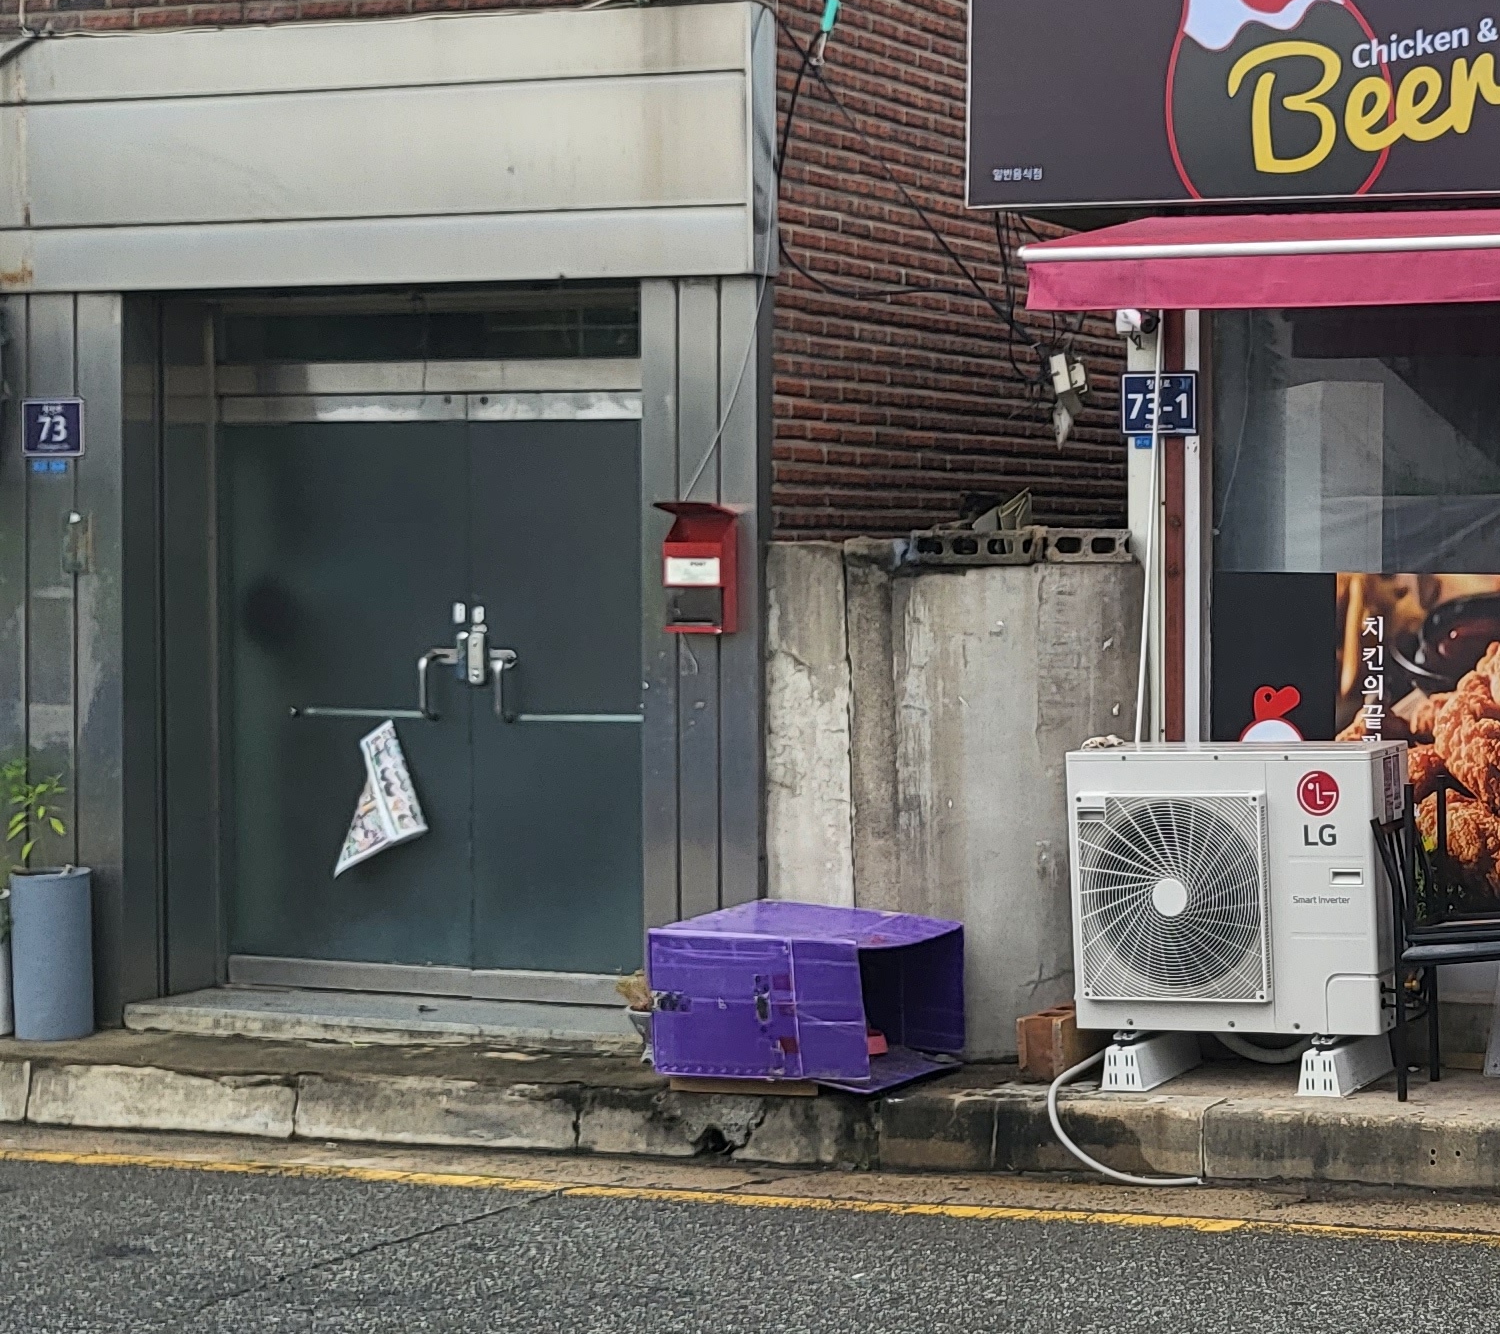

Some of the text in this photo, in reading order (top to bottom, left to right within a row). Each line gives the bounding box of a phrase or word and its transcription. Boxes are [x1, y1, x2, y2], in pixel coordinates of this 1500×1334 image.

[1351, 17, 1499, 69] Chicken &
[1127, 393, 1188, 420] 73-1
[37, 414, 67, 443] 73
[1303, 824, 1337, 846] LG
[1292, 895, 1317, 904] Smart
